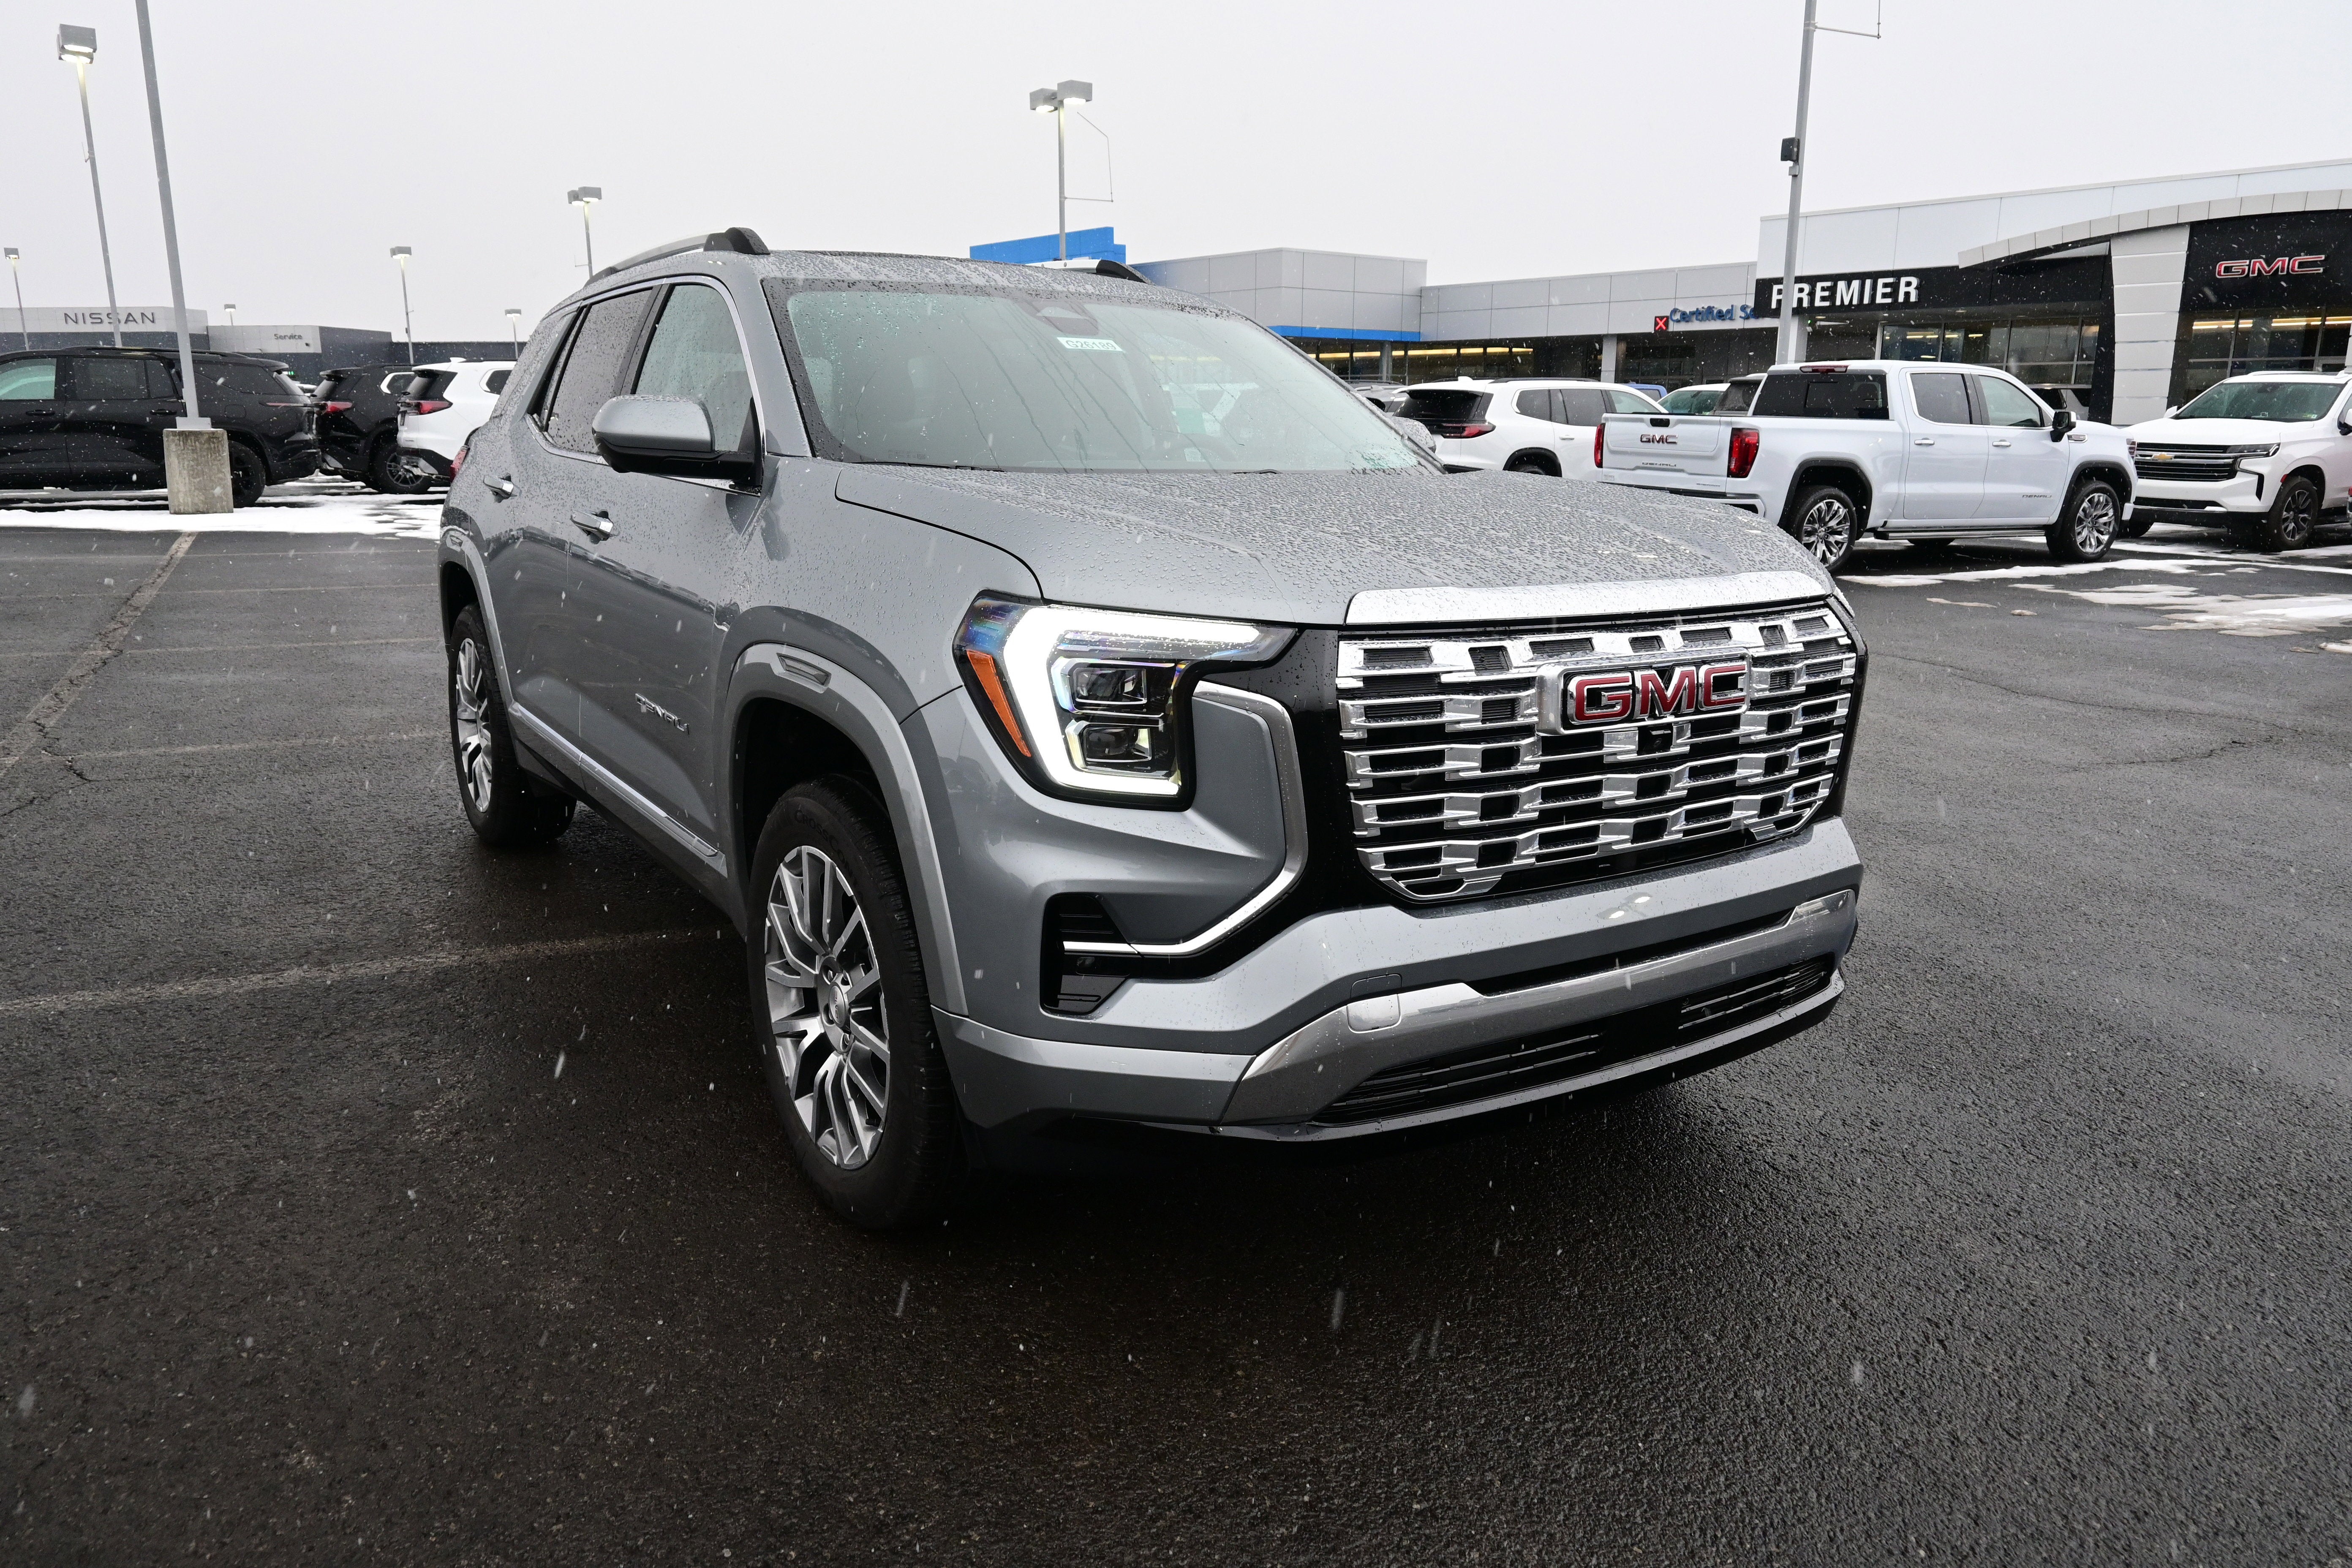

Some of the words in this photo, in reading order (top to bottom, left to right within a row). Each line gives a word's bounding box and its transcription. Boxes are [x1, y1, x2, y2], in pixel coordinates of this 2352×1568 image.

[2216, 255, 2325, 278] GMC
[1771, 276, 1919, 309] PREMIER
[64, 312, 156, 324] NISSAN
[1670, 304, 1734, 322] Certified
[1066, 340, 1117, 350] G26189
[1640, 434, 1678, 444] GMC
[1568, 662, 1747, 725] GMC
[635, 693, 689, 735] DENALI
